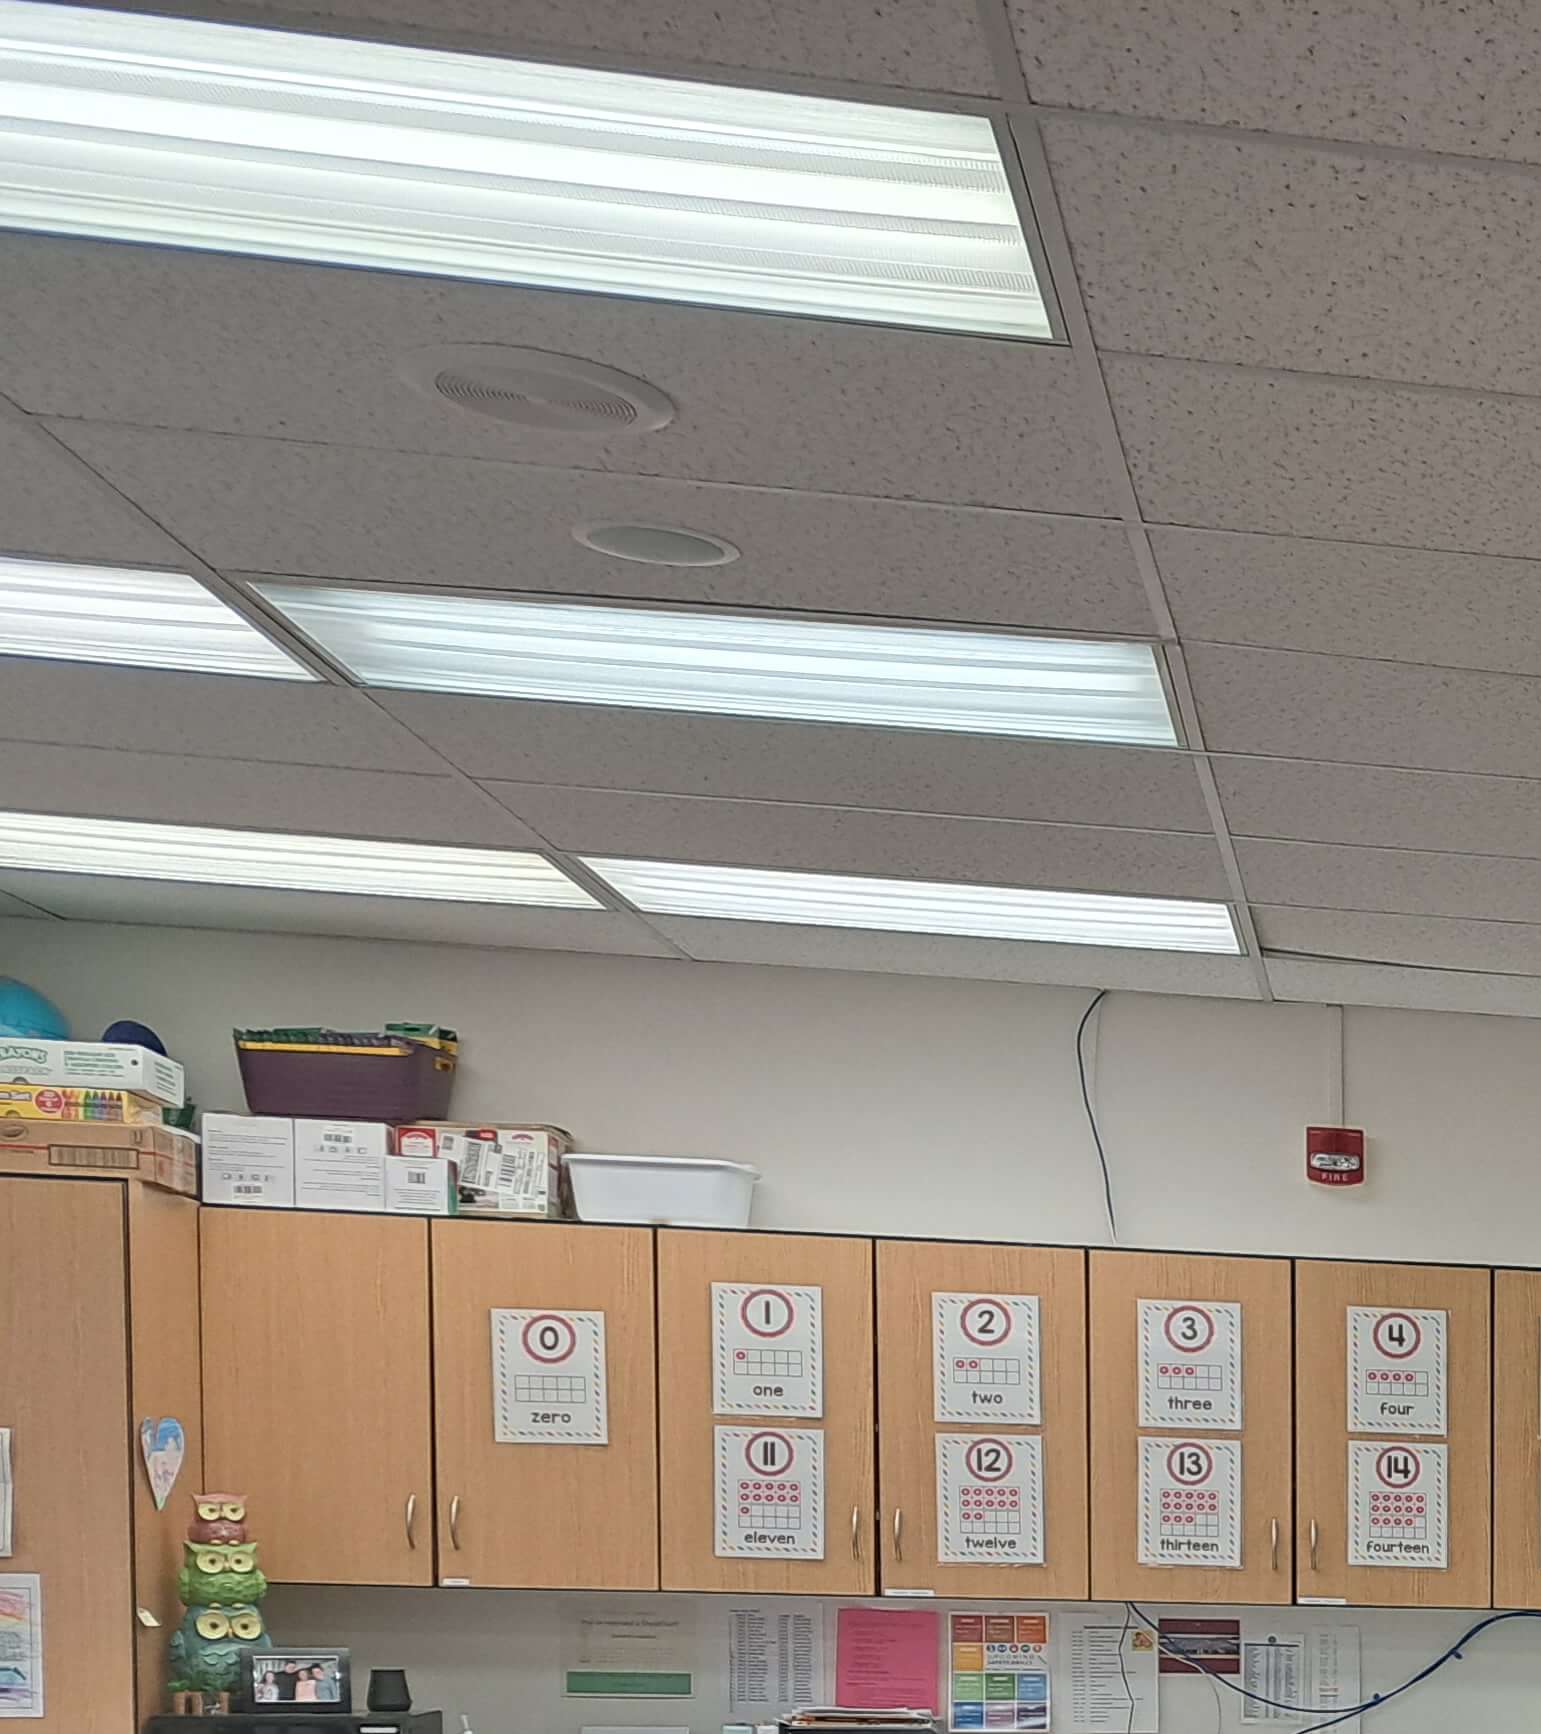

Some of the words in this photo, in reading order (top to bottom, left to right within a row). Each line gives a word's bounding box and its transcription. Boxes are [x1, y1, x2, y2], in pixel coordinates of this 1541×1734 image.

[764, 1300, 770, 1325] 1
[977, 1311, 995, 1334] 2
[1181, 1317, 1197, 1341] 3
[540, 1326, 558, 1350] 0
[1388, 1323, 1406, 1348] 4
[752, 1384, 784, 1397] one
[972, 1391, 1003, 1405] two
[1168, 1396, 1212, 1411] three
[1380, 1402, 1414, 1417] four
[531, 1411, 572, 1424] zero
[763, 1442, 776, 1466] 11
[976, 1449, 1001, 1472] 12
[1179, 1452, 1202, 1476] 13
[1387, 1455, 1411, 1479] 14
[744, 1530, 796, 1546] eleven
[965, 1535, 1017, 1550] twelve
[1160, 1538, 1220, 1553] thirteen
[1366, 1541, 1430, 1555] fourteen
